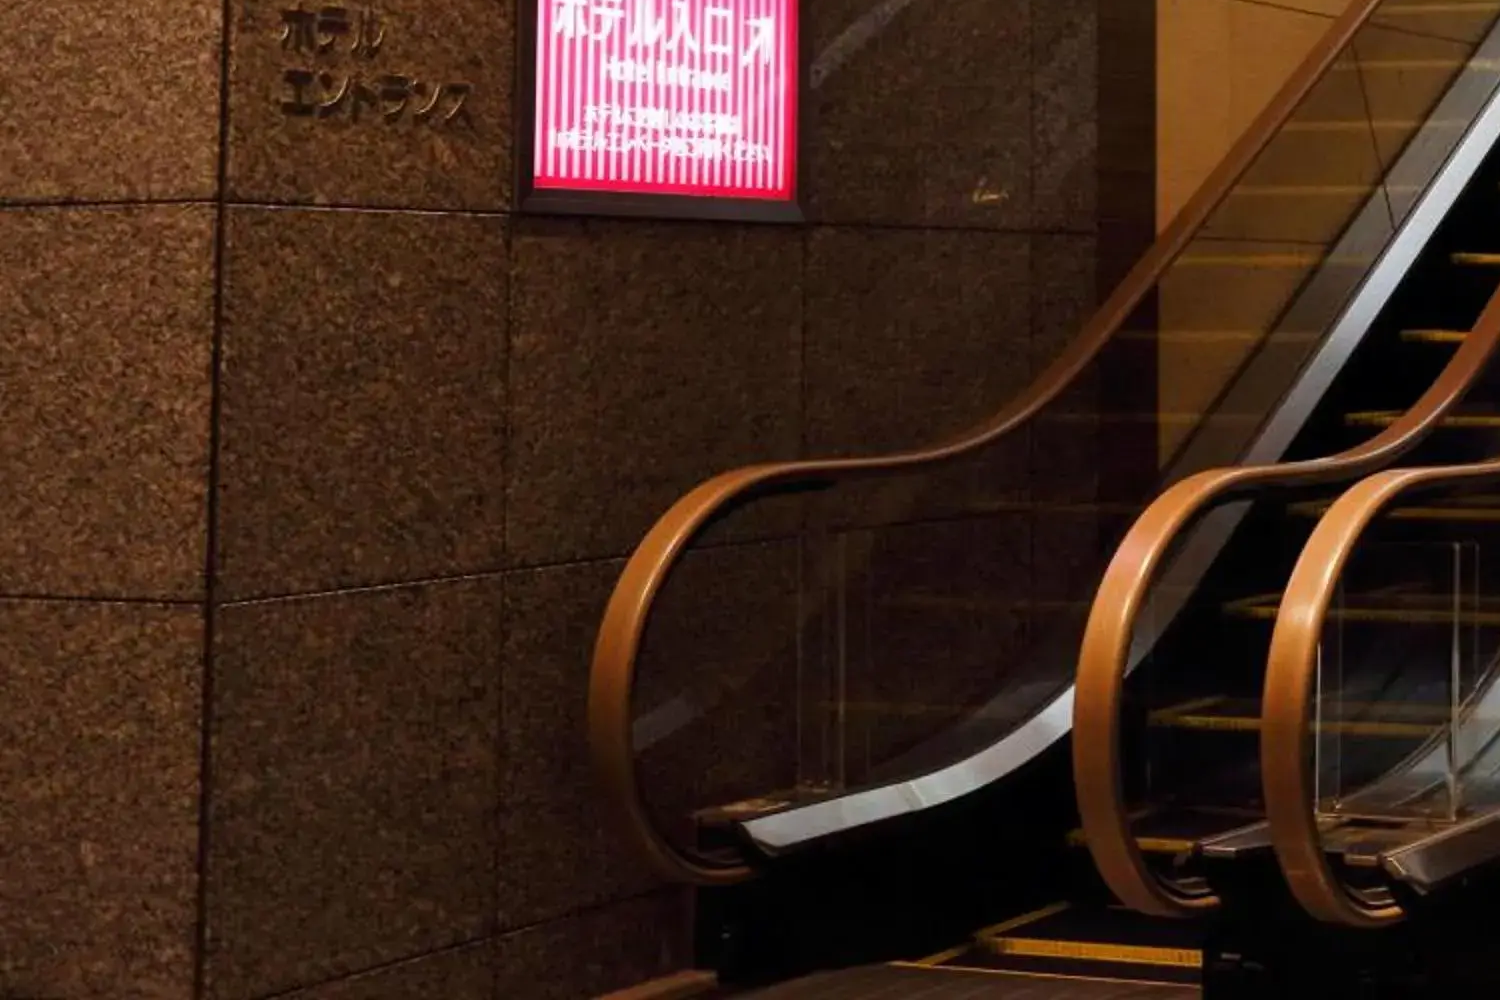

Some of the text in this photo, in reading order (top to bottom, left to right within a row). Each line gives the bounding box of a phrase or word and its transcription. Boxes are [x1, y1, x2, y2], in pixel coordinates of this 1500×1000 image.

[280, 3, 387, 59] ホテル
[280, 67, 477, 131] エントランス
